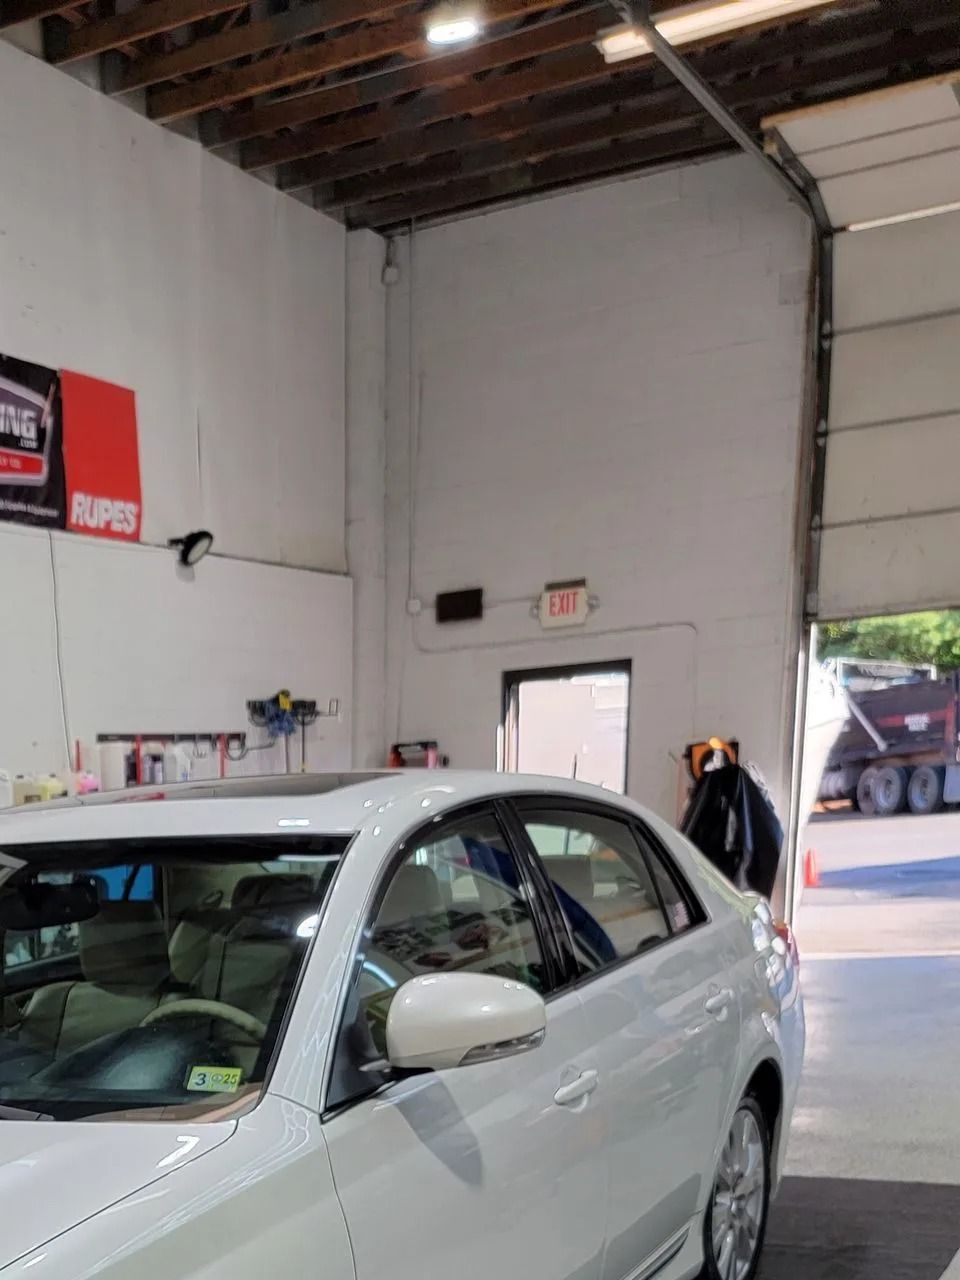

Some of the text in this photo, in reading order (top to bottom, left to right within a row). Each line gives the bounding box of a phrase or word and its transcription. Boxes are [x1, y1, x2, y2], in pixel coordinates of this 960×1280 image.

[71, 491, 136, 535] RUPES
[548, 590, 578, 617] EXIT
[195, 1073, 238, 1086] 3 25
